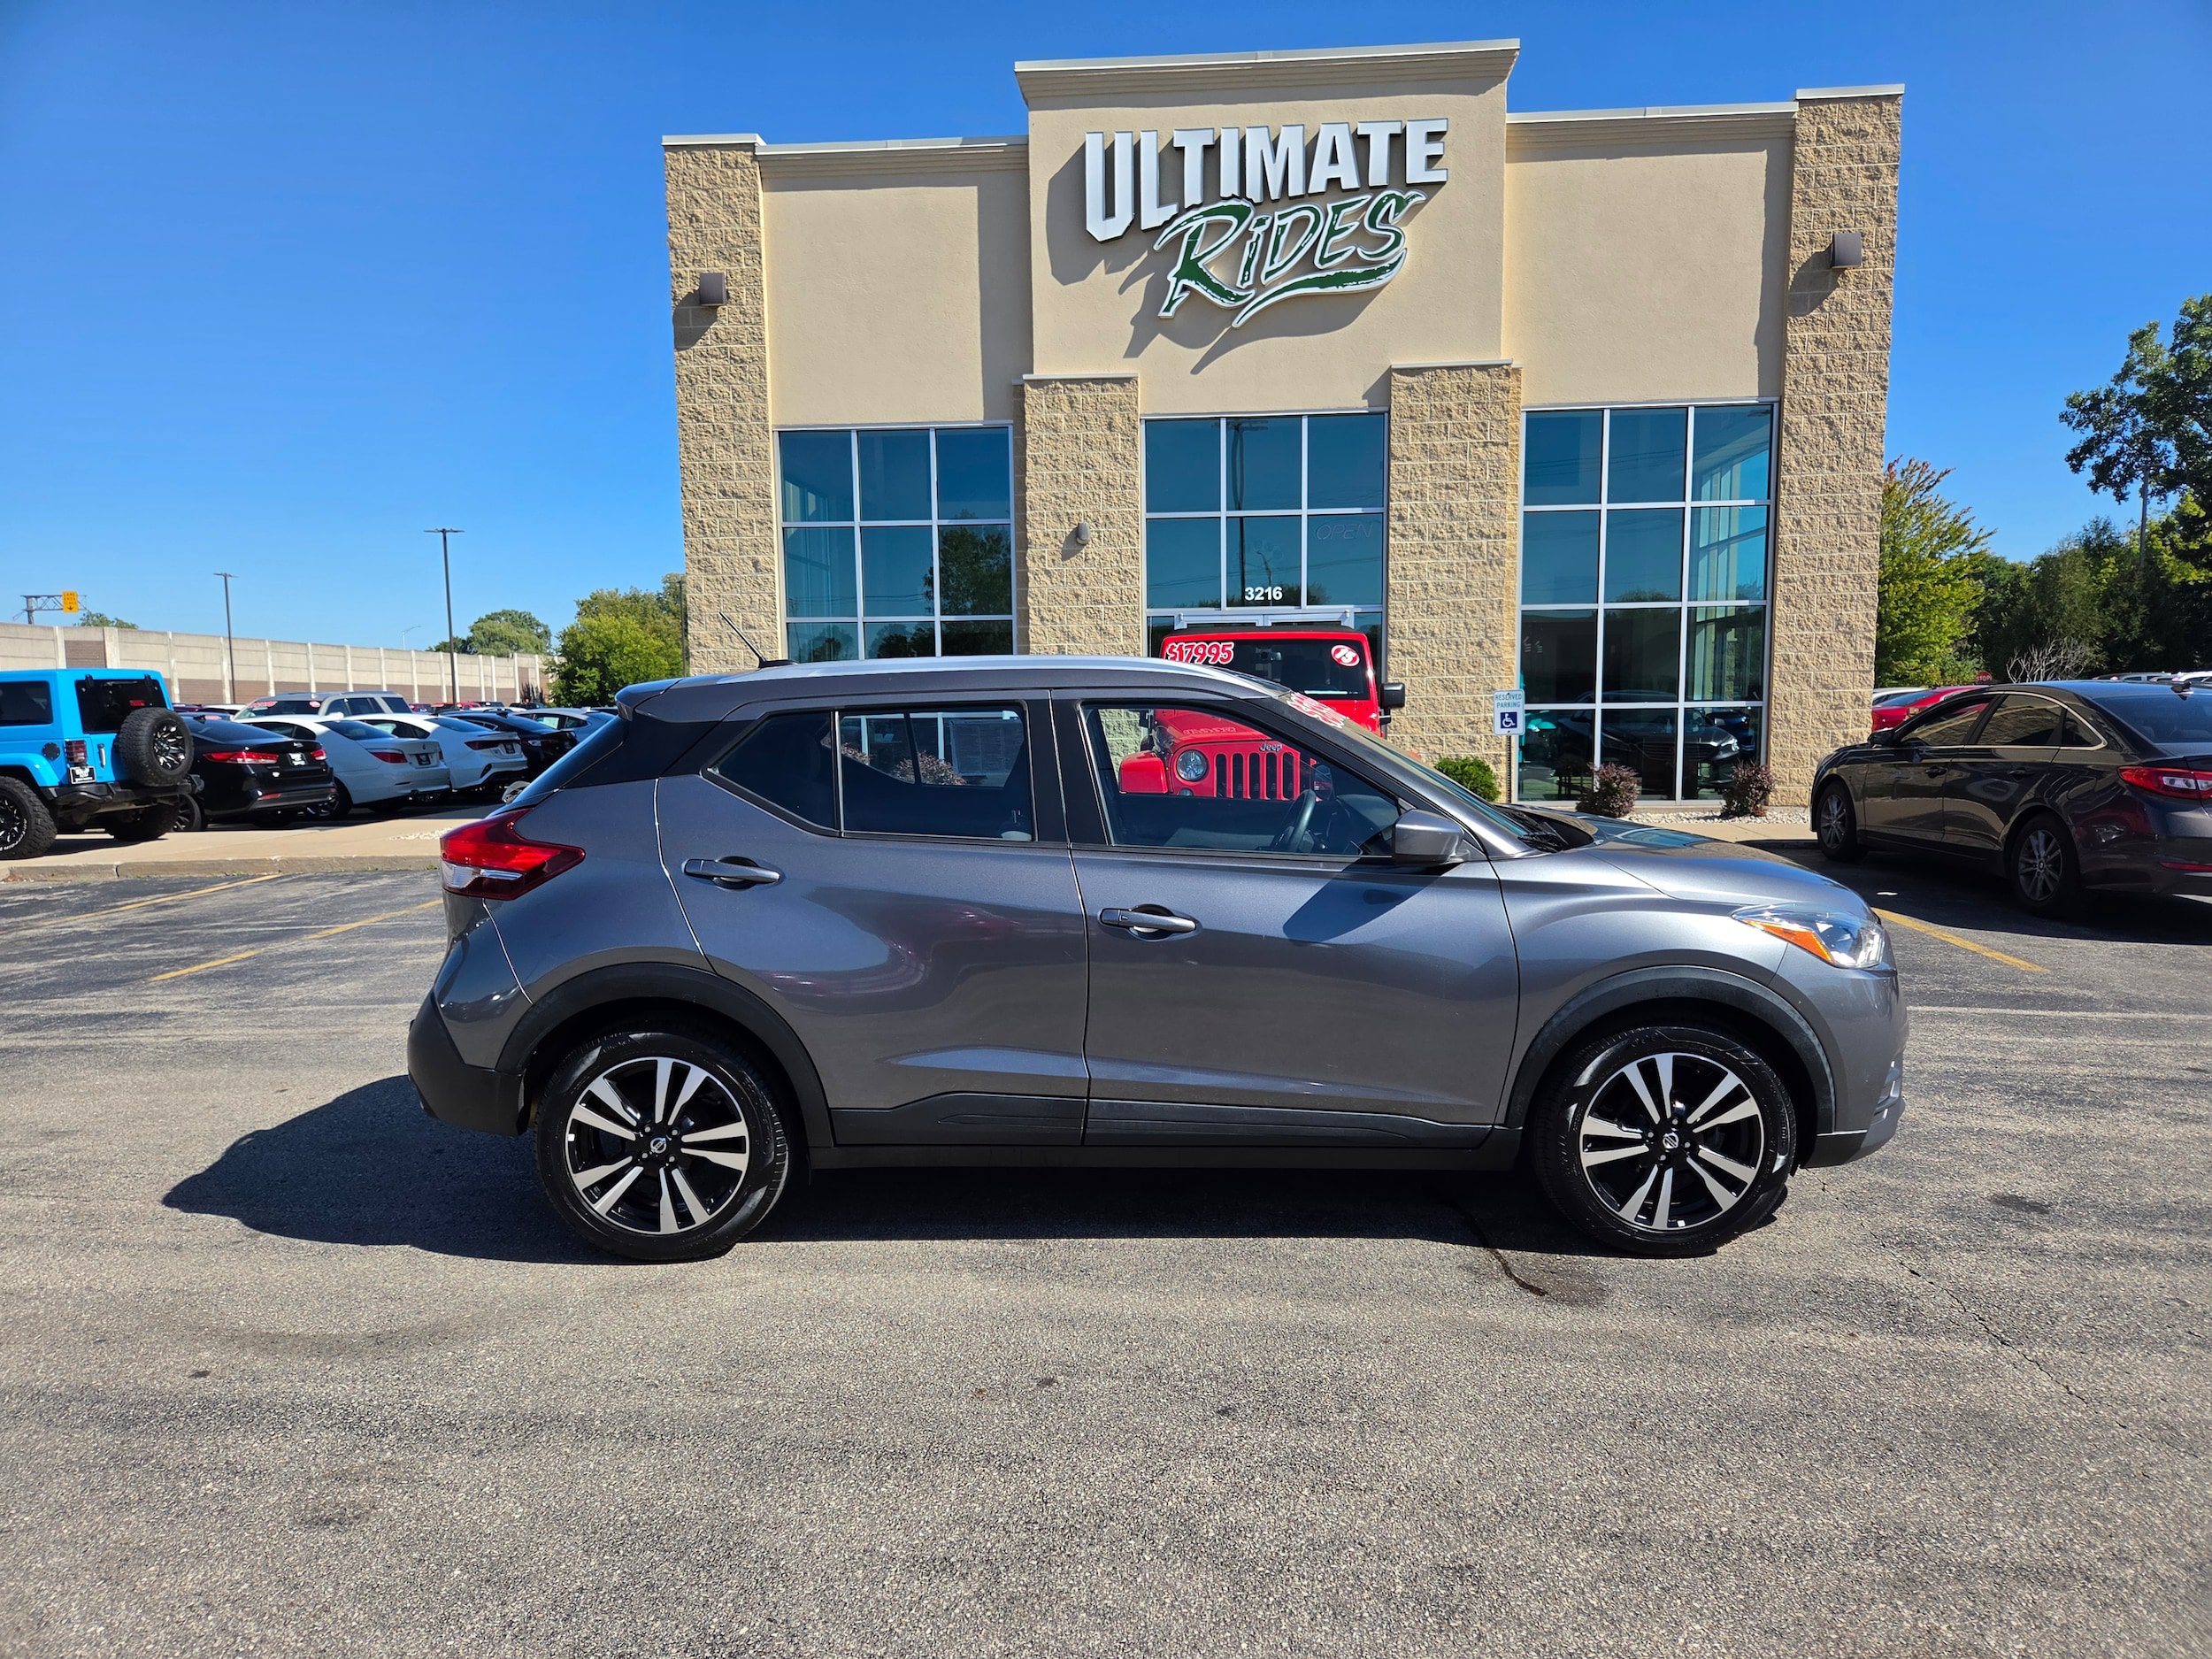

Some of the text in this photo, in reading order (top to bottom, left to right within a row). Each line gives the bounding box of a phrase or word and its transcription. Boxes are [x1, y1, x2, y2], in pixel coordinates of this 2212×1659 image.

[1085, 118, 1448, 242] ULTIMATE
[1317, 524, 1372, 540] OPEN
[1244, 587, 1283, 601] 3216
[1168, 641, 1234, 665] $17995
[1334, 648, 1357, 664] 15
[1260, 743, 1282, 752] Jeep
